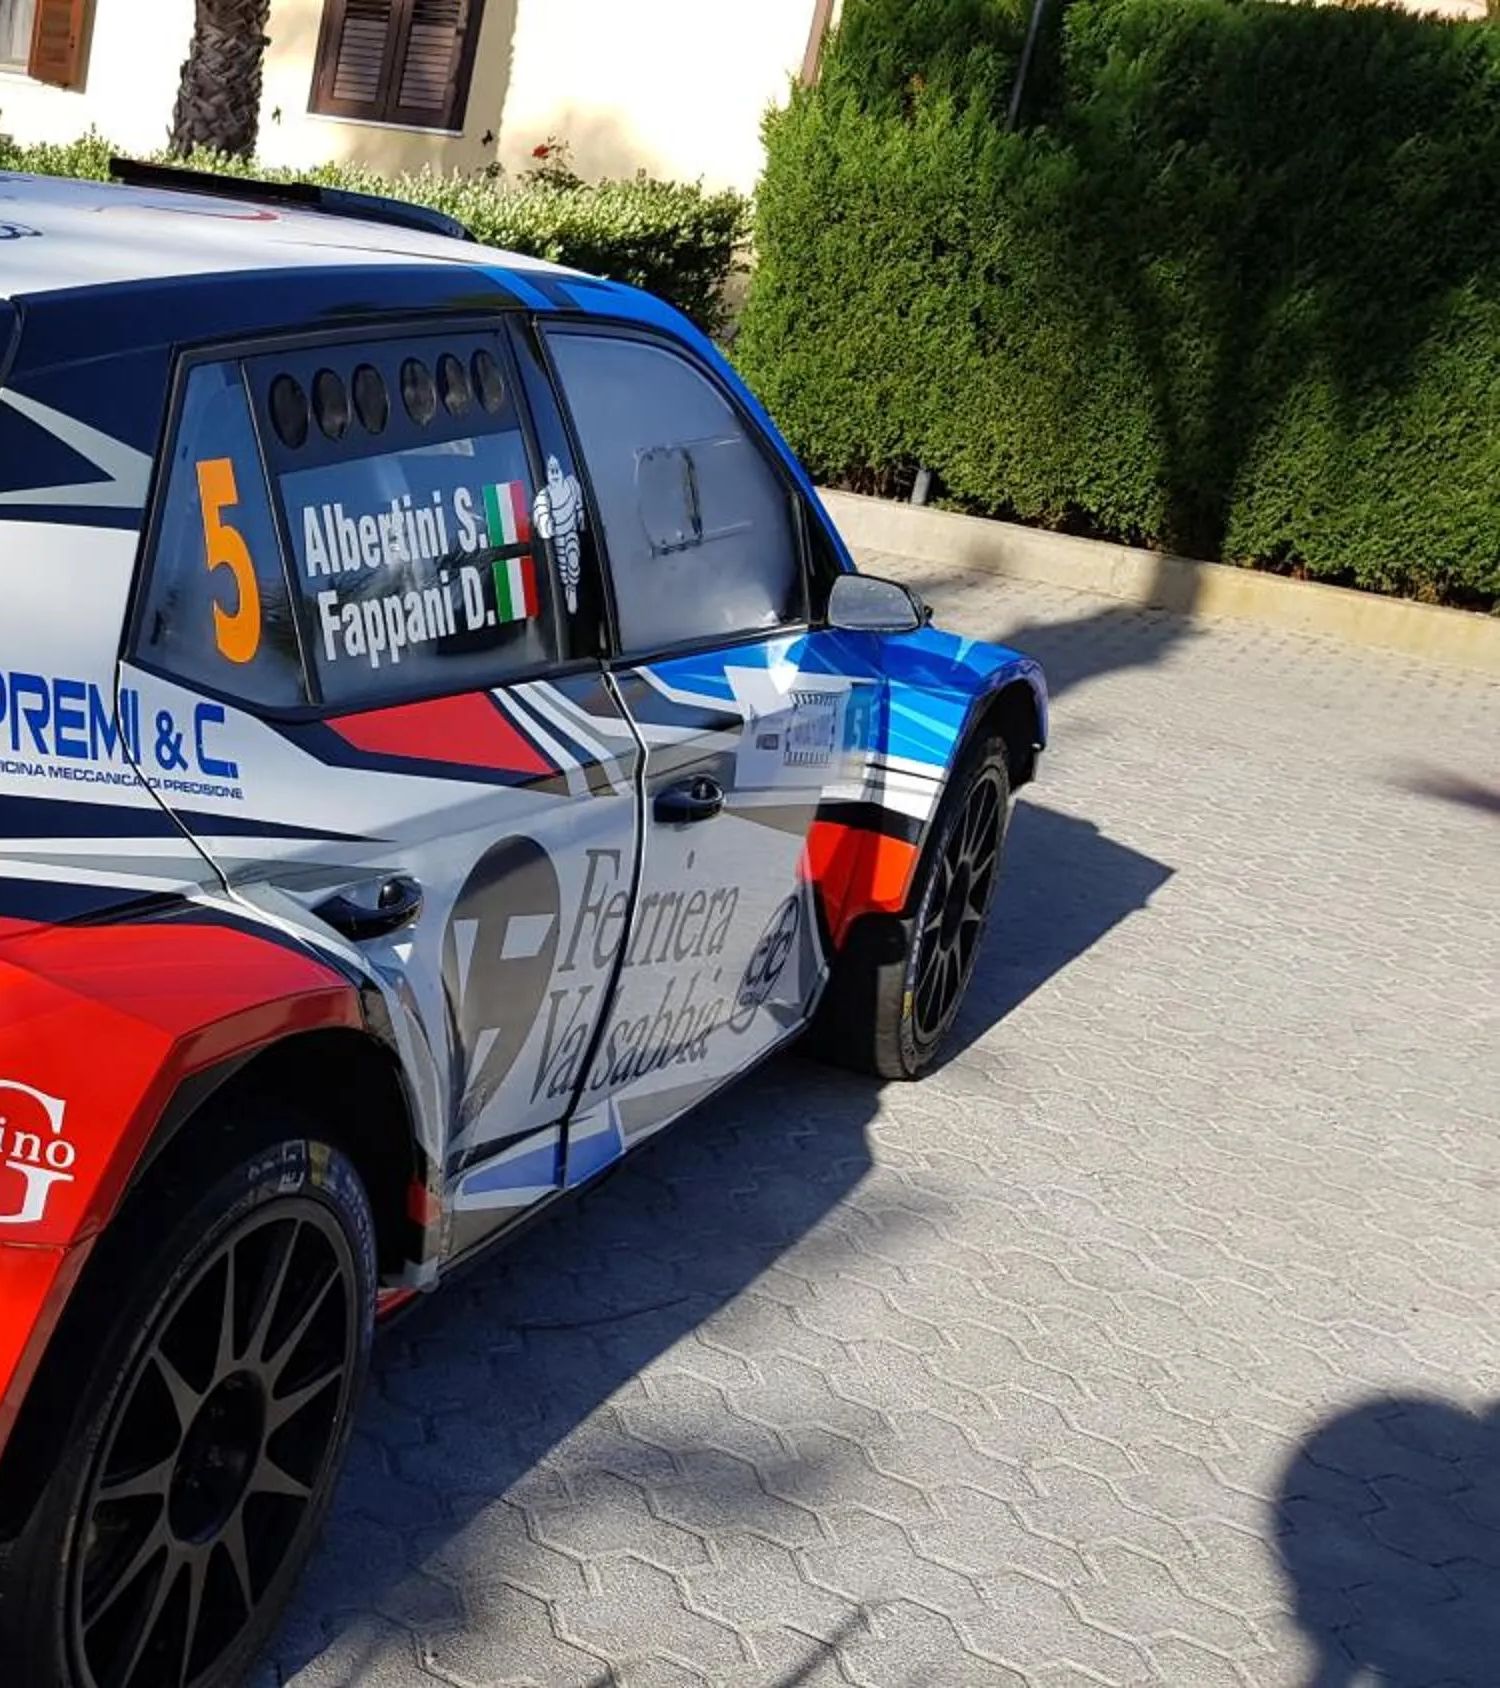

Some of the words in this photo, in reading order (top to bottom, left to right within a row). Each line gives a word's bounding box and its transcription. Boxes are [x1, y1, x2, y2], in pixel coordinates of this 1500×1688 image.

[195, 457, 261, 663] 5
[303, 489, 449, 577] Albertini
[454, 487, 488, 553] S.
[317, 569, 457, 669] Fappani
[460, 565, 497, 631] D.
[48, 765, 144, 788] MECCANICA
[163, 778, 244, 800] PRECISIONE
[154, 709, 190, 772] &
[558, 848, 740, 973] Ferriera
